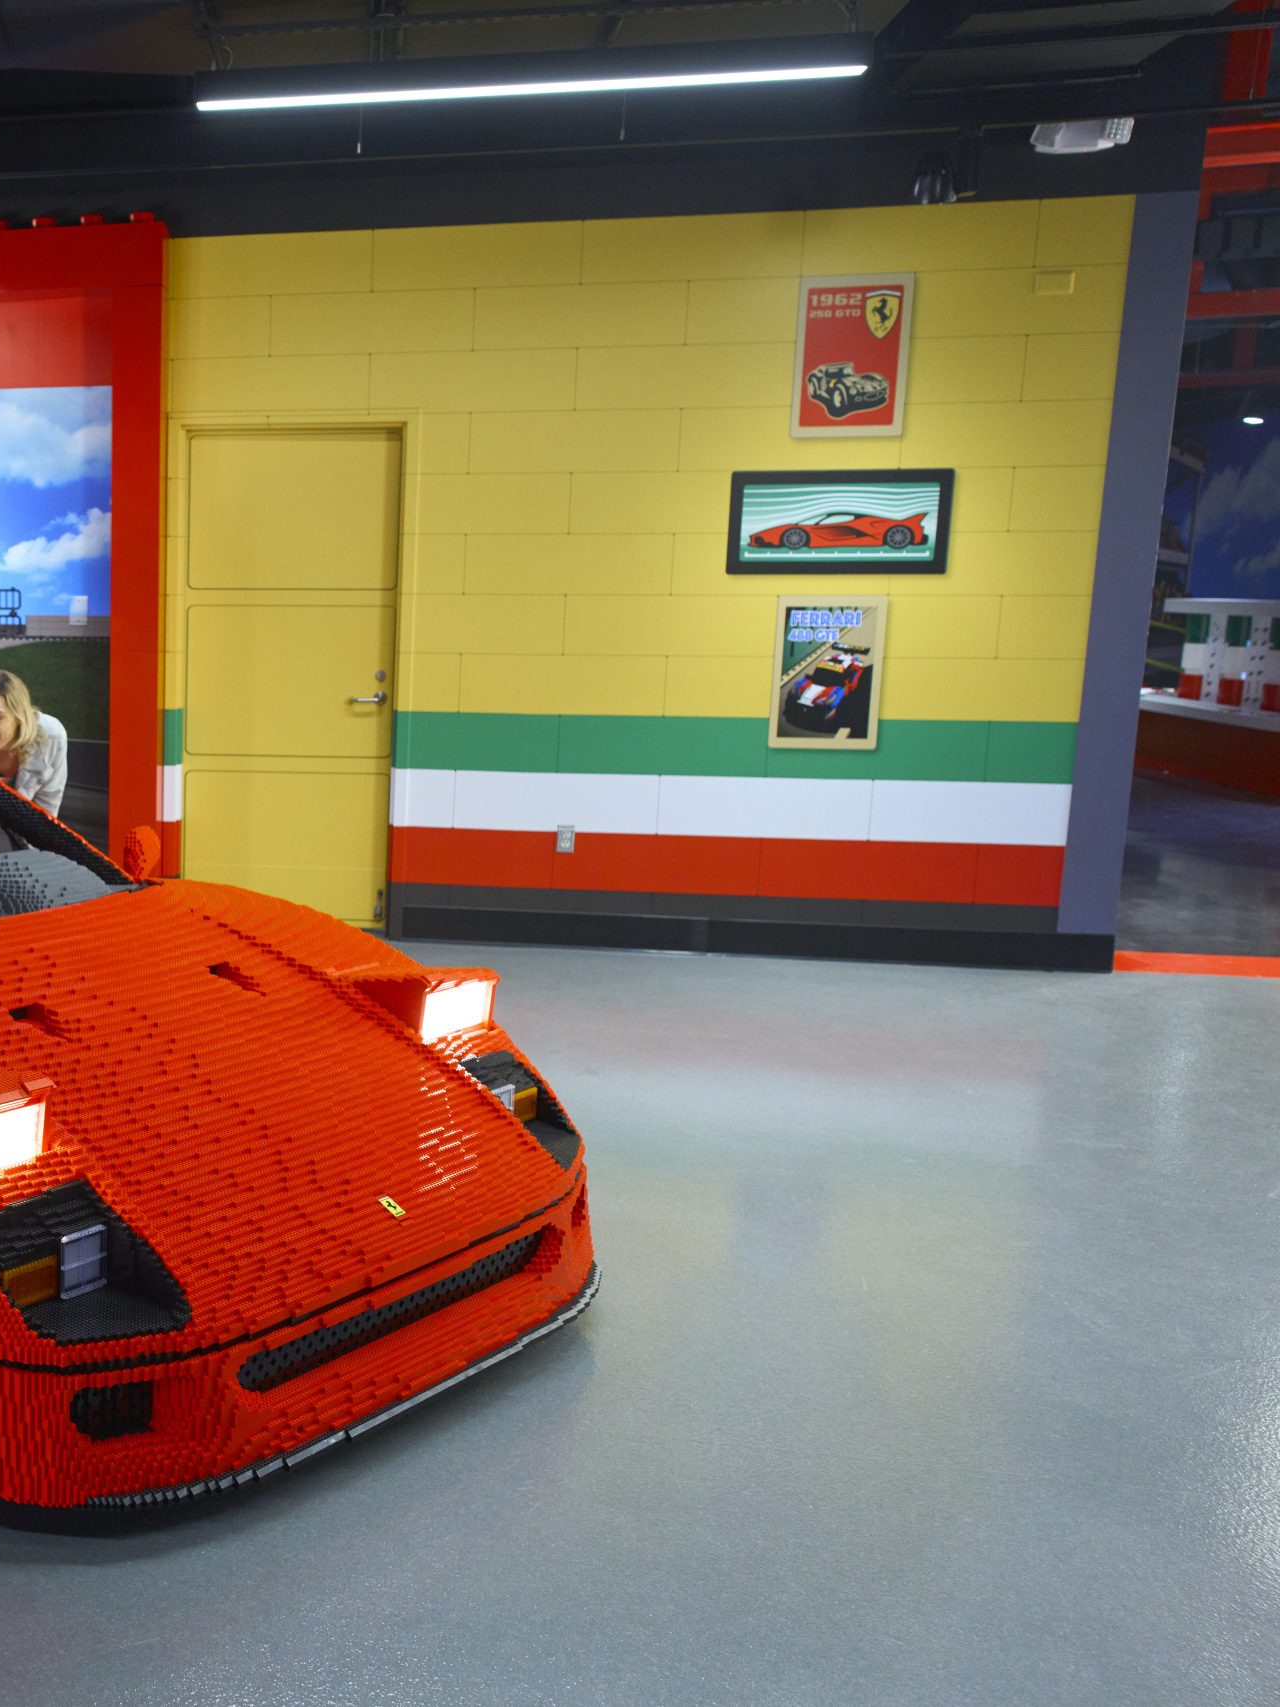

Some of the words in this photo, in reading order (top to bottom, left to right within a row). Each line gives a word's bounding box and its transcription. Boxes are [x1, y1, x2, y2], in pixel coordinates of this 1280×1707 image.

[810, 293, 862, 306] 1962
[809, 309, 832, 318] 250
[835, 308, 861, 318] GTO
[790, 610, 862, 627] FERRARI
[788, 628, 813, 642] 488
[815, 628, 839, 642] GTE
